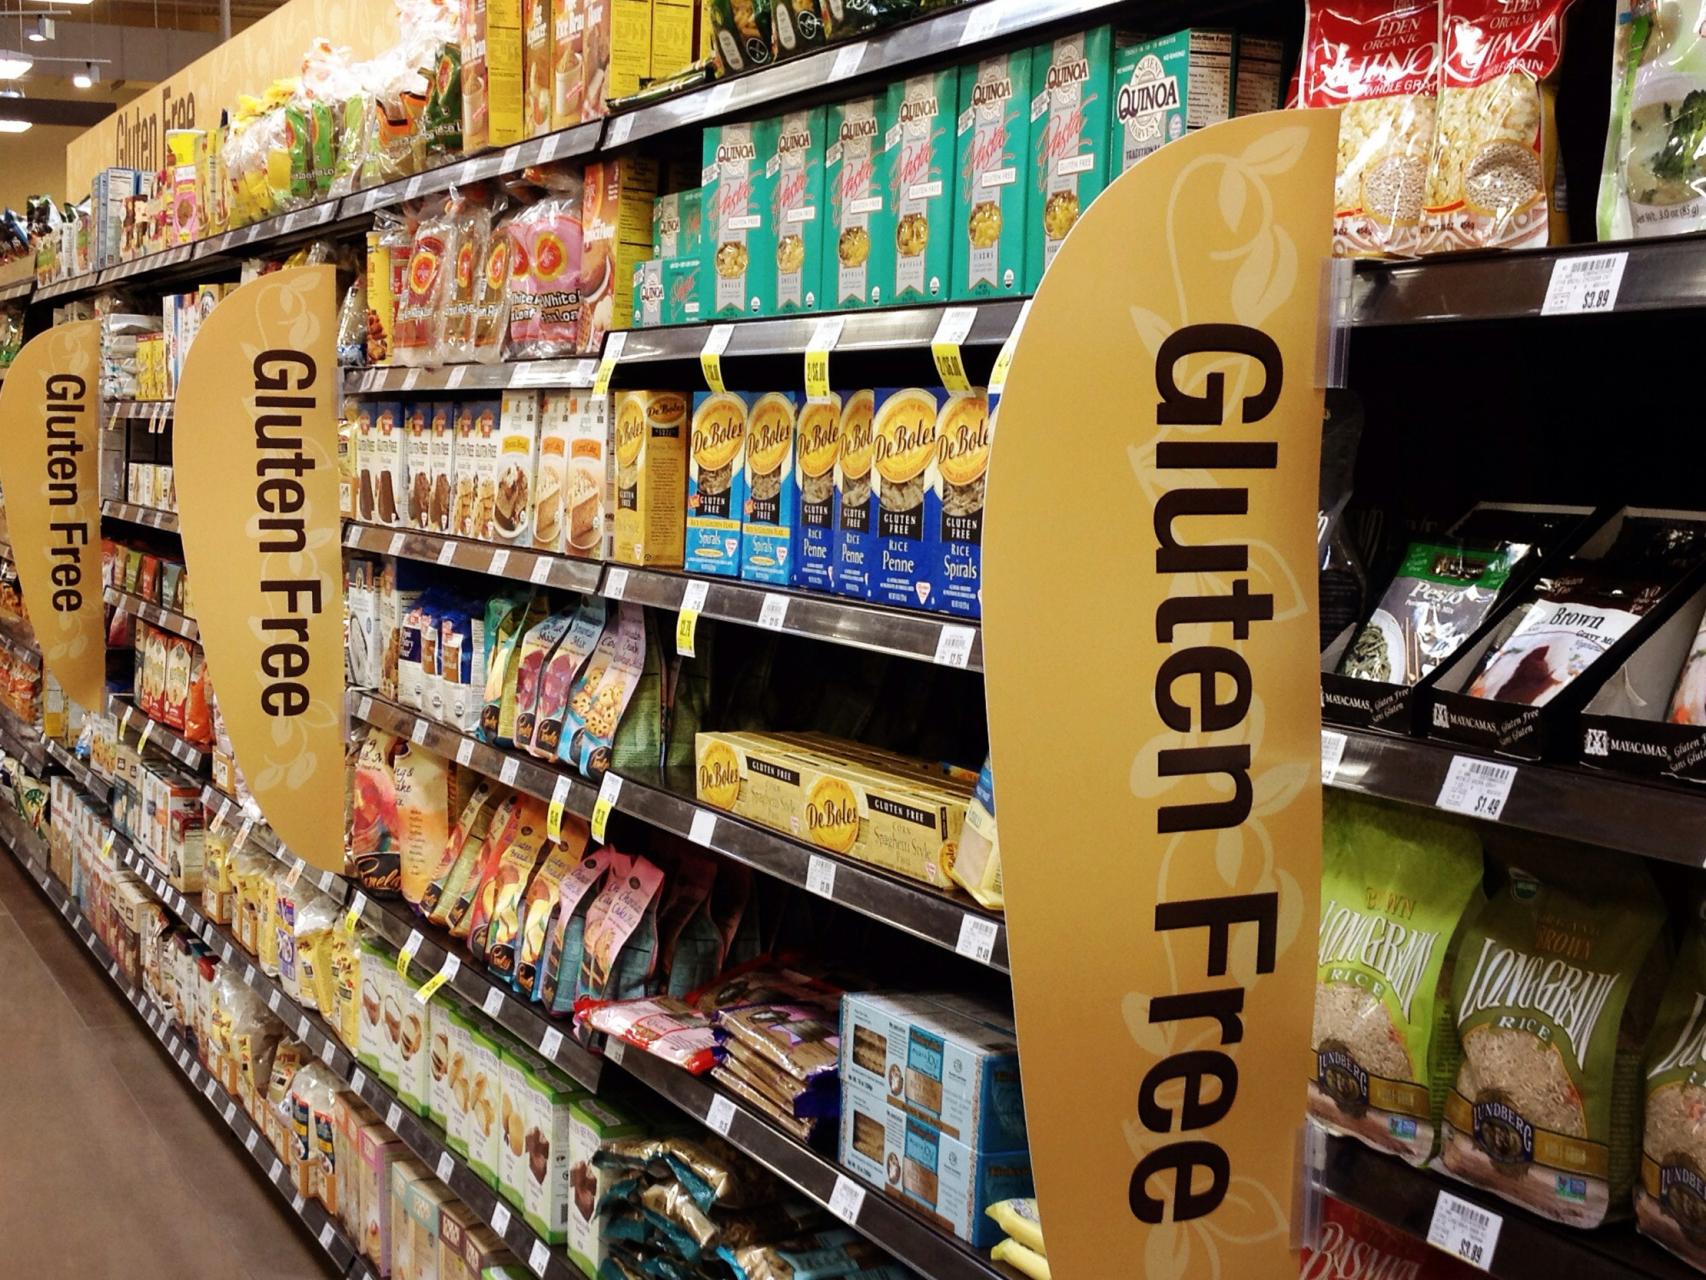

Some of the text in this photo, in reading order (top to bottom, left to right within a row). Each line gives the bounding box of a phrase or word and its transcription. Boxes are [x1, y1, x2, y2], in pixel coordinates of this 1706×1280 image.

[1375, 18, 1420, 38] EDEN
[1362, 33, 1420, 51] ORGANIC
[1047, 62, 1089, 89] QUINOA
[973, 80, 1011, 105] QUINOA
[1118, 80, 1179, 120] QUINOA
[900, 100, 938, 122] QUINOA
[115, 107, 157, 172] Gluten
[841, 120, 877, 140] QUINOA
[779, 133, 810, 153] QUINOA
[717, 145, 755, 162] QUINOA
[660, 218, 680, 233] QUINOA
[541, 291, 576, 309] White
[641, 285, 663, 301] QUINOA
[1582, 289, 1611, 309] $3.89
[45, 374, 87, 506] Gluten
[693, 417, 743, 454] De Boles
[748, 419, 790, 458] De Boles
[840, 418, 873, 460] De Bol
[875, 419, 936, 463] De Boles
[938, 418, 989, 465] De Bole
[253, 350, 317, 553] Gluten
[800, 434, 811, 460] De
[700, 496, 725, 505] GLUTEN
[704, 504, 719, 514] FREE
[753, 502, 776, 511] GLUTEN
[804, 504, 828, 514] GLUTEN
[757, 511, 771, 521] FREE
[808, 514, 822, 524] FREE
[843, 508, 866, 520] GLUTEN
[847, 518, 861, 528] FREE
[884, 513, 916, 525] GLUTEN
[946, 517, 978, 529] GLUTEN
[698, 529, 721, 547] Spirals
[808, 528, 822, 539] RICE
[846, 532, 860, 544] RICE
[889, 524, 909, 535] FREE
[952, 528, 970, 540] FREE
[803, 538, 827, 559] Penne
[842, 543, 864, 565] Penne
[889, 540, 908, 552] RICE
[951, 543, 970, 557] RICE
[49, 522, 89, 612] Free
[883, 551, 915, 574] Penne
[944, 556, 978, 581] Spirals
[1154, 322, 1284, 834] Gluten
[1409, 581, 1464, 605] Pesto
[1549, 607, 1606, 630] Brown
[1575, 630, 1602, 642] Gravy
[260, 580, 322, 718] Free
[1325, 692, 1371, 711] MAYACAMAS
[1375, 687, 1410, 711] Gluten Free
[1384, 701, 1405, 719] Gluten
[1450, 713, 1498, 733] MAYACAMAS
[1501, 708, 1540, 733] Gluten Free
[1512, 724, 1534, 742] Gluten
[1610, 738, 1668, 758] MAYACAMAS
[1673, 738, 1701, 759] Gluten
[1686, 749, 1706, 767] Glute
[700, 764, 714, 790] De
[714, 761, 739, 787] Boles
[752, 760, 792, 781] GLUTEN FREE
[806, 802, 823, 830] De
[824, 798, 857, 827] Boles
[874, 800, 925, 822] GLUTEN FREE
[1474, 796, 1501, 816] $1.49
[1331, 966, 1385, 995] RICE
[1498, 1015, 1551, 1042] RICE
[1128, 892, 1279, 1225] Free
[1473, 1102, 1532, 1153] LUNDBERG
[1459, 1237, 1483, 1263] $3.89
